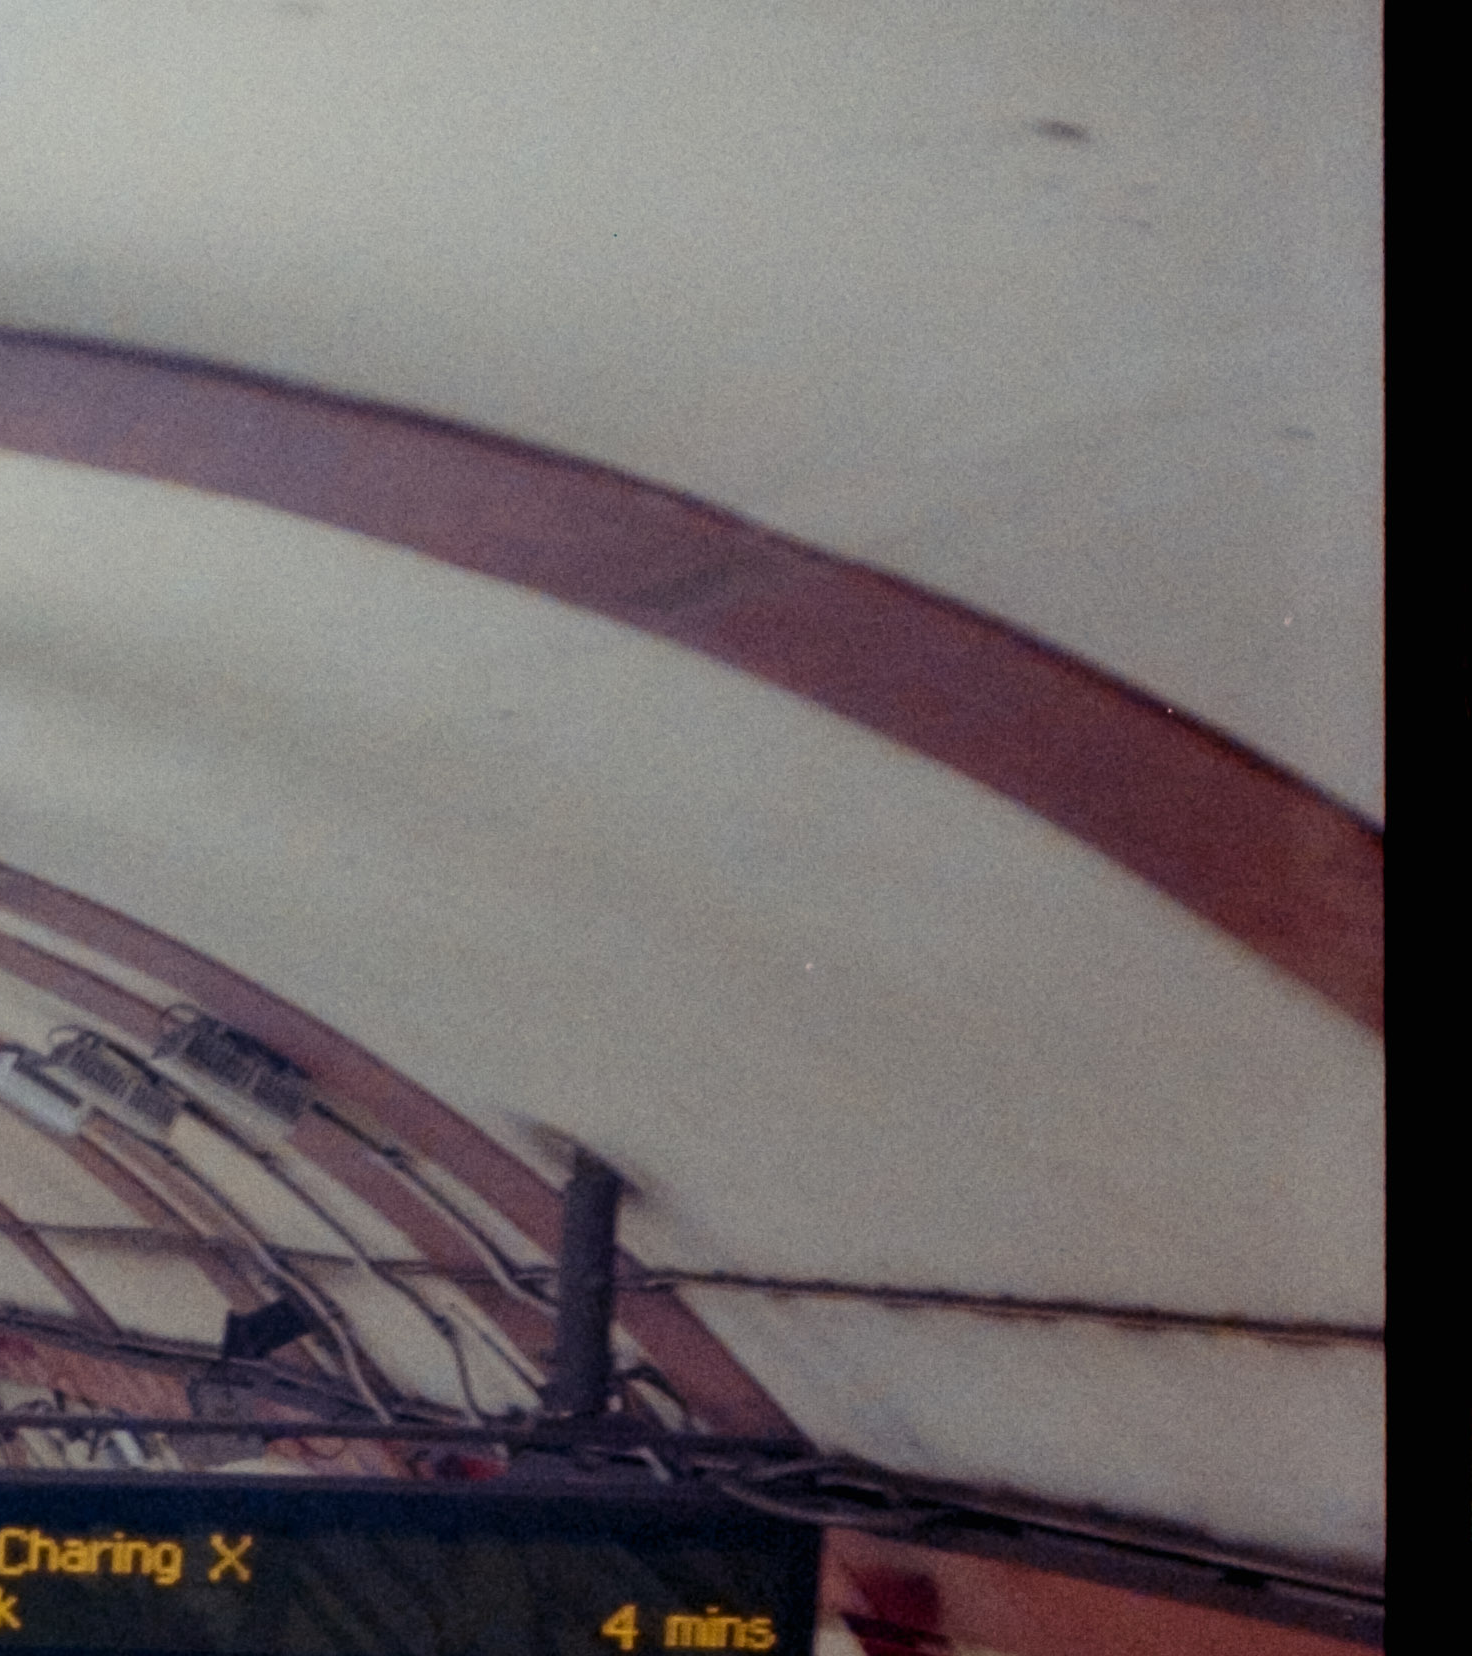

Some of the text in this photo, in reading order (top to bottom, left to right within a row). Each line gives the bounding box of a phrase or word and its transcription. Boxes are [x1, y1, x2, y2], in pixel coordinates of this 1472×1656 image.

[207, 1533, 253, 1583] X
[600, 1603, 640, 1651] 4
[663, 1605, 777, 1651] mins
